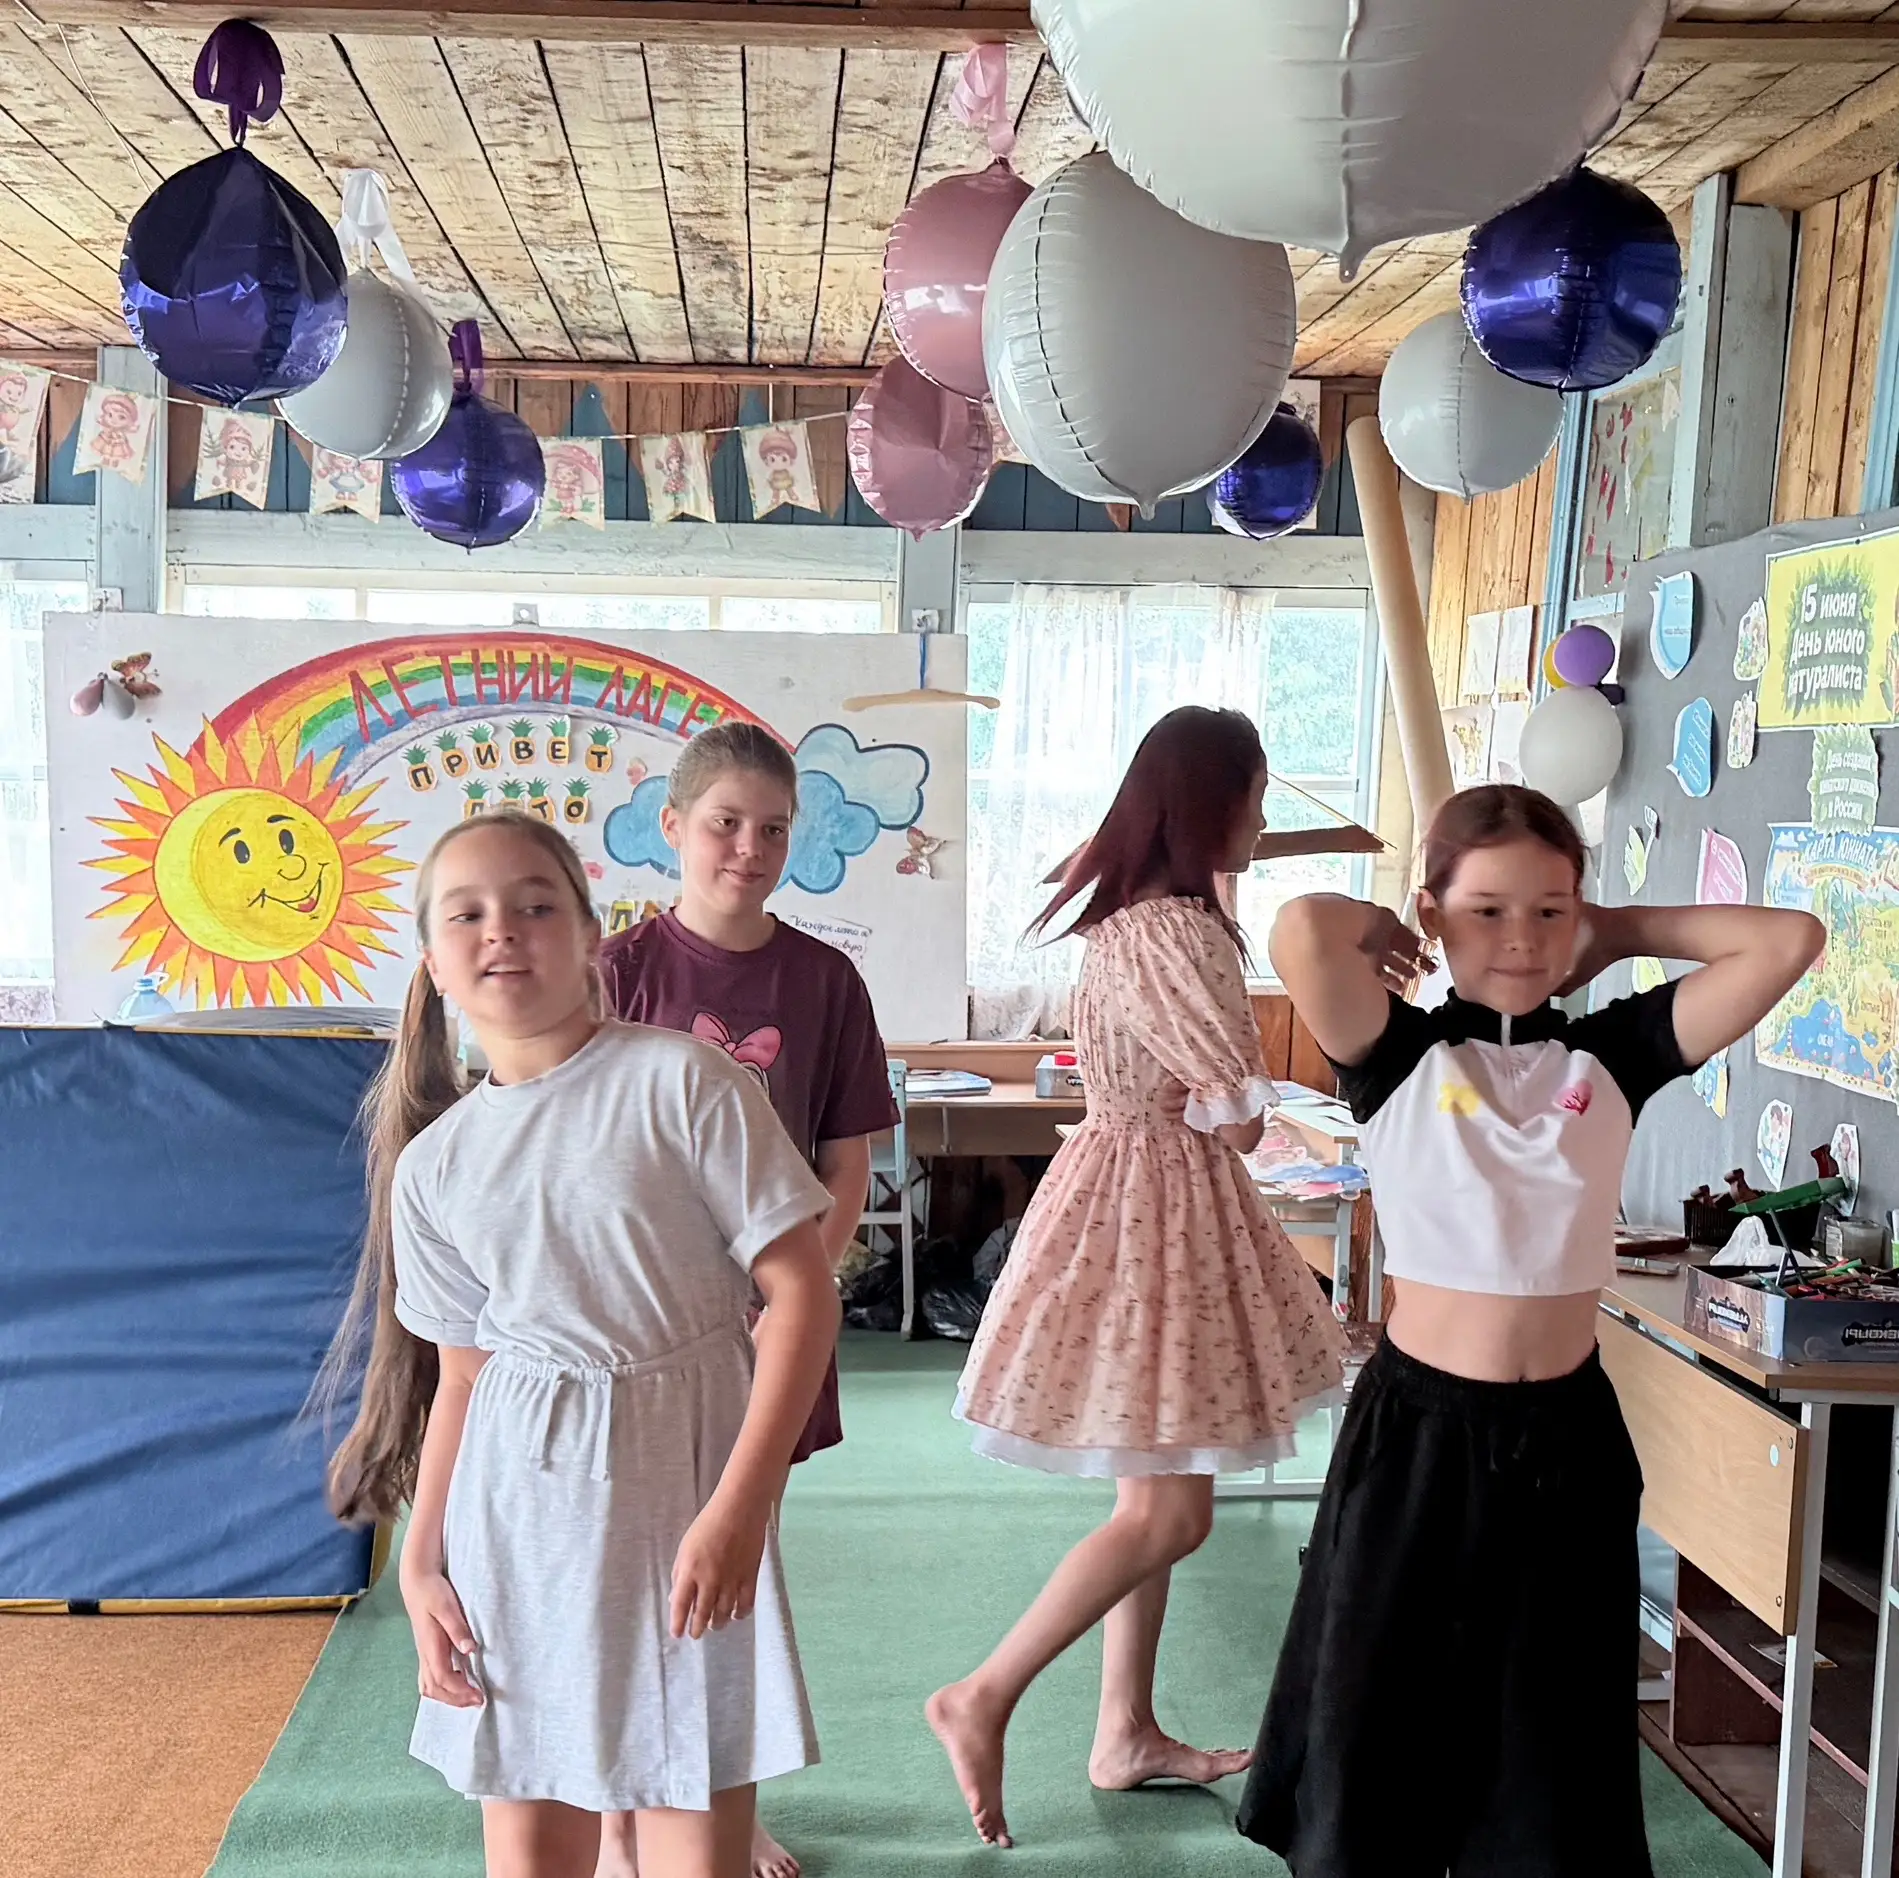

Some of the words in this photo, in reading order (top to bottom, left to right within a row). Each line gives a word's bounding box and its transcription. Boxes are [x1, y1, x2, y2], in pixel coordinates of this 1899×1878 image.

[1801, 583, 1818, 624] 15
[1820, 592, 1857, 619] июня
[1789, 628, 1822, 669] День
[1824, 628, 1866, 656] юного
[411, 740, 610, 788] ПРИВЕТ
[469, 798, 586, 819] ЛТО
[1804, 836, 1836, 863] КАРТА
[1837, 836, 1878, 872] ЮННАТА
[1845, 1328, 1899, 1339] ЕКОПЫ
